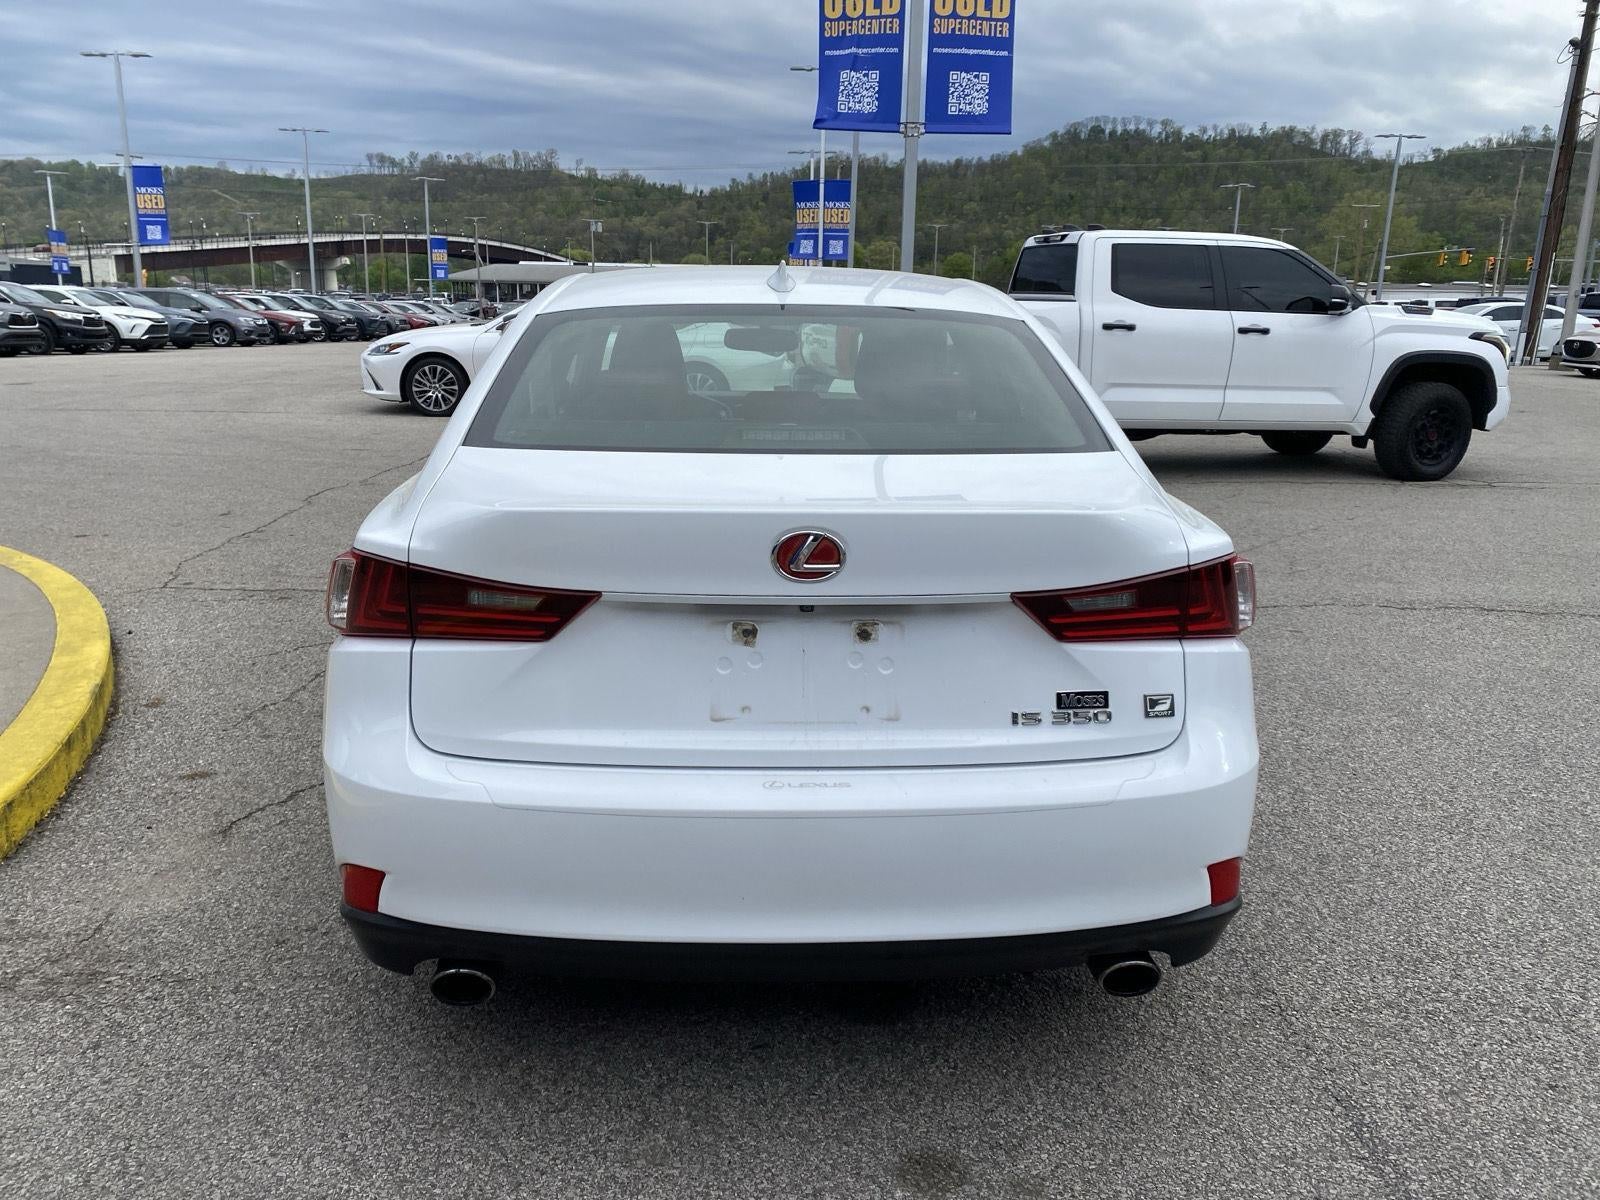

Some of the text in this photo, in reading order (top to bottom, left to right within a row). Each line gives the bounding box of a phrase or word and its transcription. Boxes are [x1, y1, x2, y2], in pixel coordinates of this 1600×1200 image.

[824, 18, 900, 38] SUPERCENTER
[933, 18, 1009, 38] SUPERCENTER
[824, 46, 899, 56] mosesusedsupercenter.com
[933, 46, 1009, 56] mosesusedsupercenter.com
[136, 194, 165, 209] USED
[824, 208, 850, 223] USED
[1061, 693, 1105, 708] MOSES
[1011, 710, 1112, 725] IS 350
